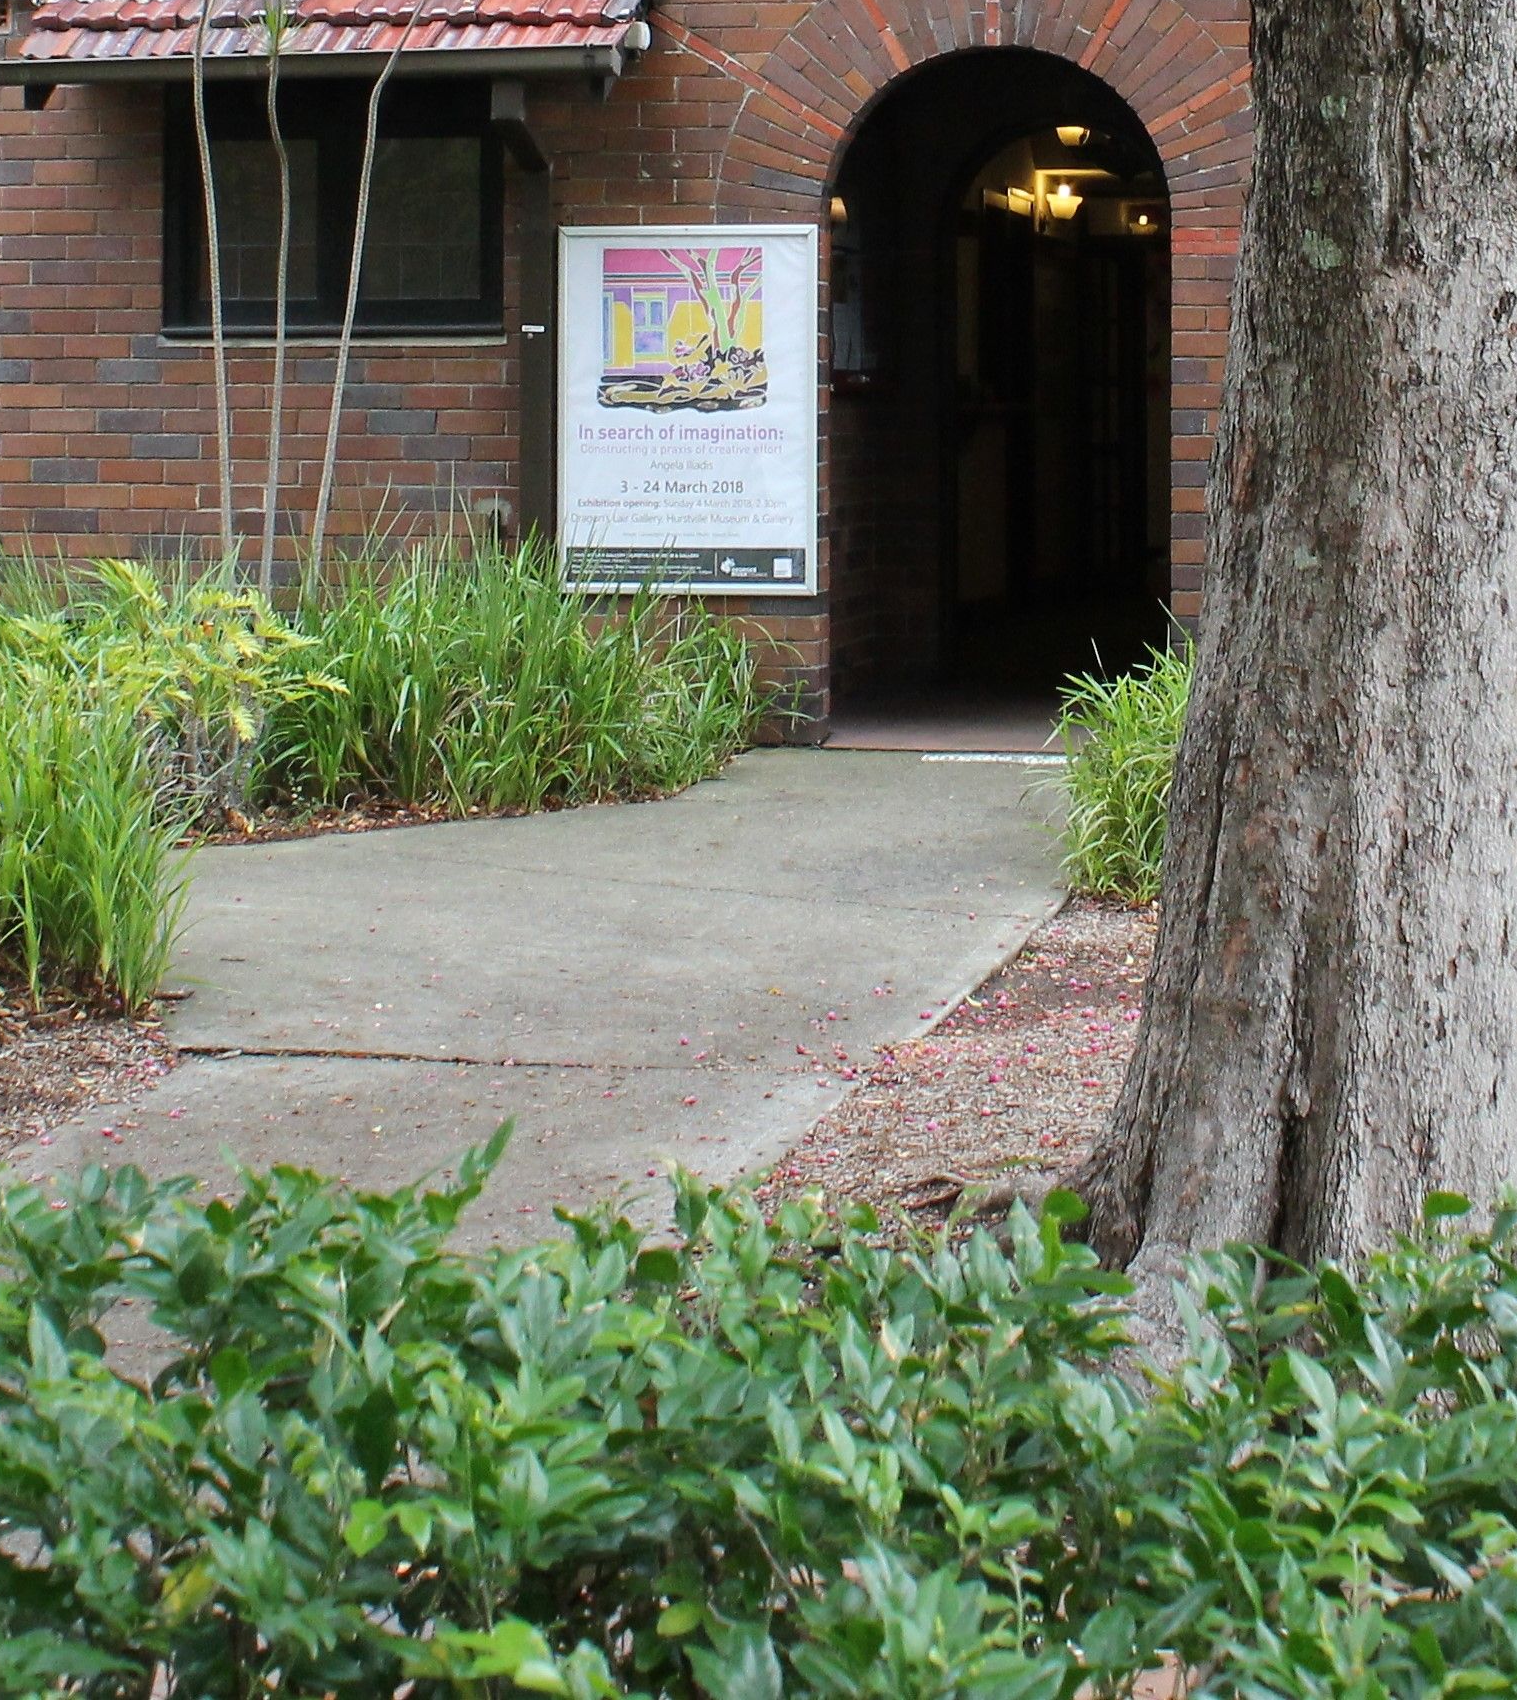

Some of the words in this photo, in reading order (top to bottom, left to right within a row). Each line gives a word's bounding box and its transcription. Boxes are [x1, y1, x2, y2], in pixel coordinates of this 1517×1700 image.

[579, 425, 593, 440] In
[598, 425, 654, 440] search
[659, 425, 674, 440] of
[679, 425, 784, 443] imagination:
[581, 444, 647, 455] Constructing
[652, 446, 657, 454] a
[660, 444, 692, 455] praxis
[695, 444, 706, 454] of
[708, 444, 749, 454] creative
[753, 443, 782, 454] effort
[650, 460, 683, 471] Angela
[621, 481, 628, 493] 3
[644, 481, 660, 493] 24
[665, 480, 707, 493] March
[713, 481, 743, 493] 2018
[578, 499, 620, 508] Exhibition
